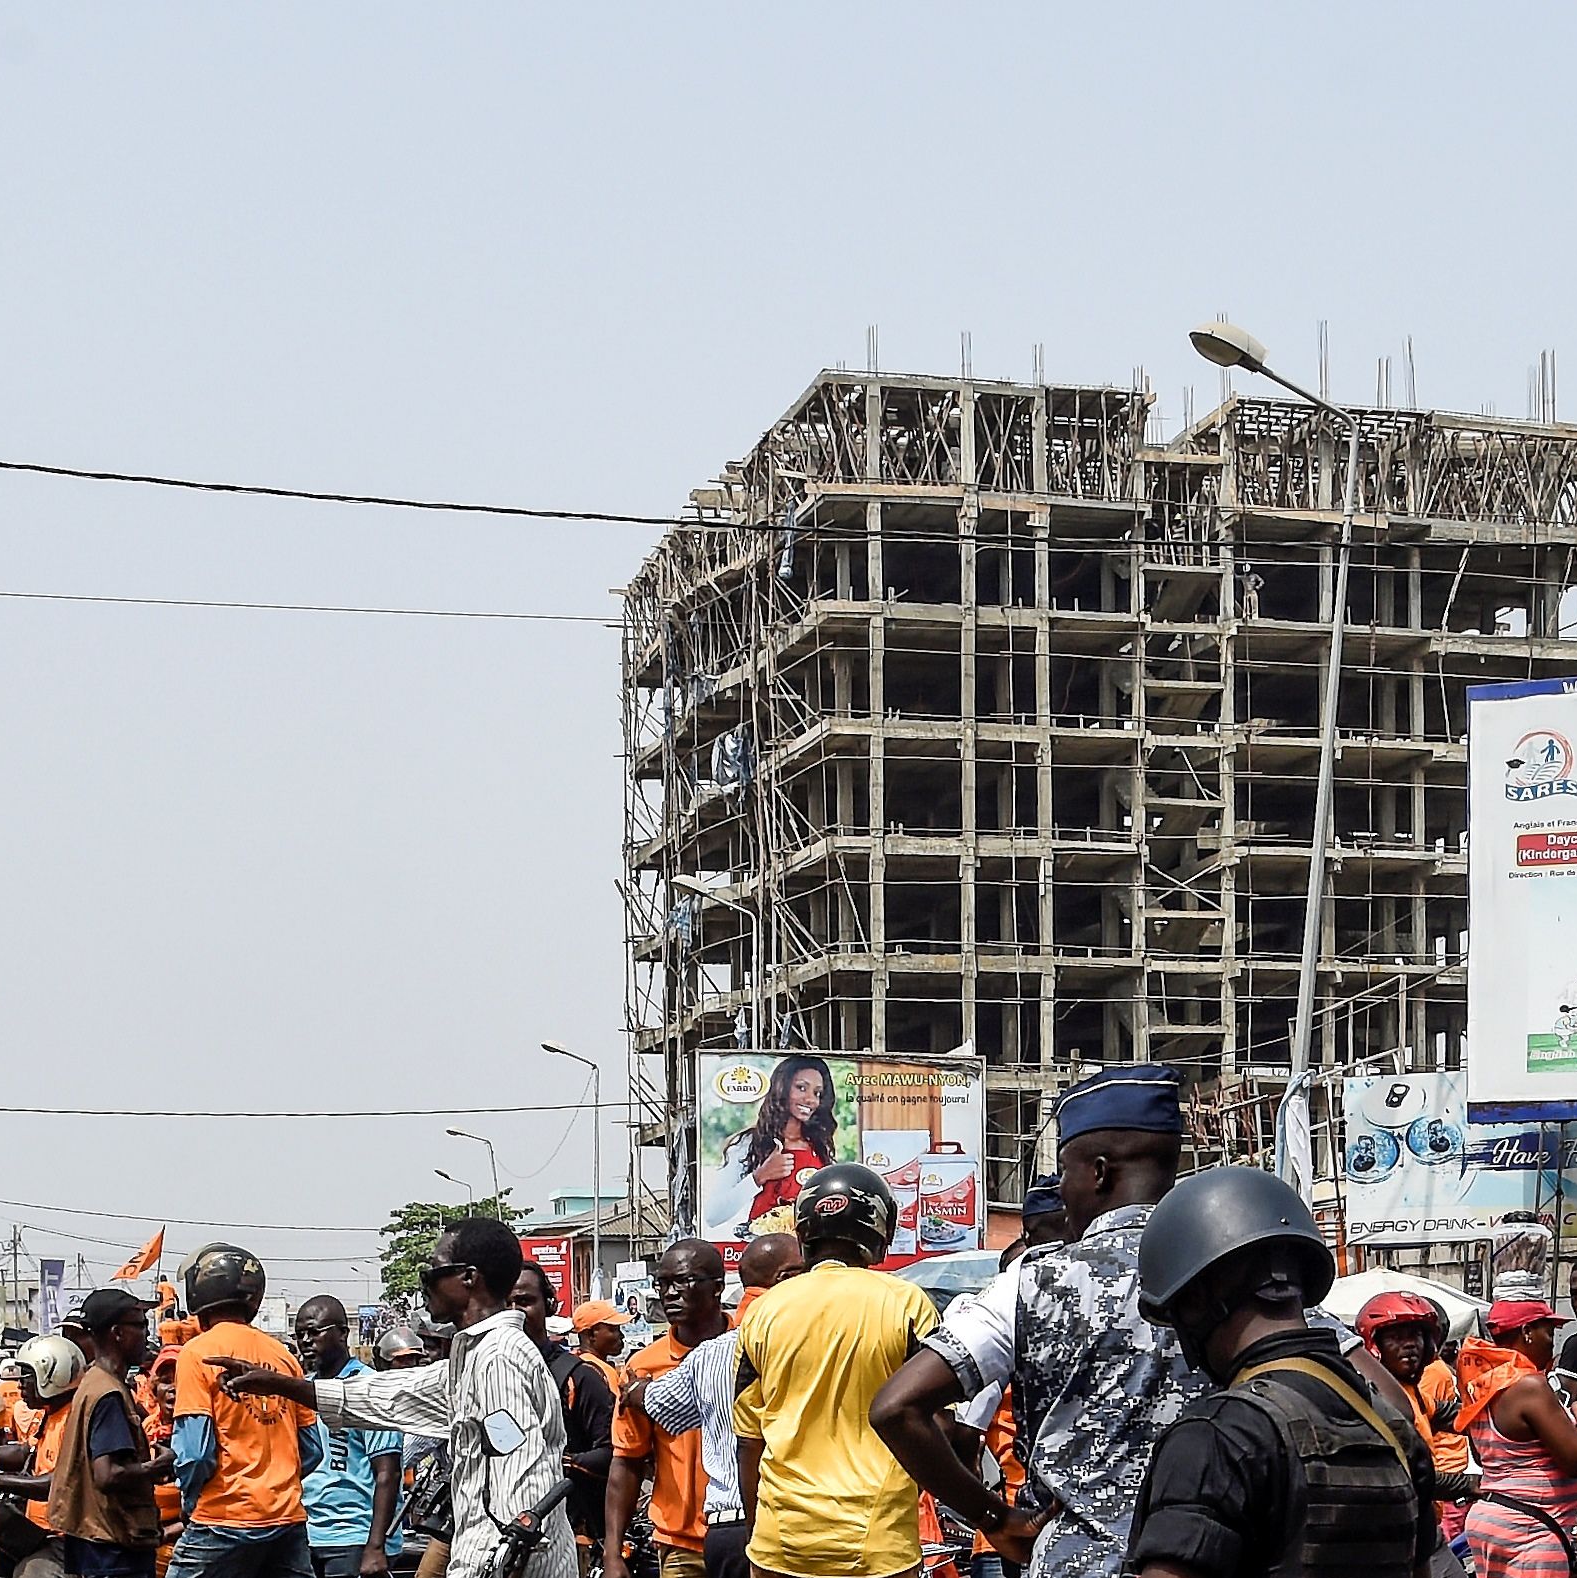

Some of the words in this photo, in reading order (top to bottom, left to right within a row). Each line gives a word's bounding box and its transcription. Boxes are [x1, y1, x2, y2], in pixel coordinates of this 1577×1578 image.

[1507, 781, 1577, 800] SARES
[1513, 821, 1545, 830] Anglais
[845, 1073, 878, 1086] Avec
[880, 1073, 971, 1088] MAWU-NYON,
[846, 1092, 852, 1103] la
[856, 1092, 884, 1105] qualité
[900, 1096, 928, 1106] gagne
[1492, 1139, 1551, 1168] Have
[923, 1200, 967, 1217] JASMIN
[1350, 1219, 1420, 1235] ENERGY
